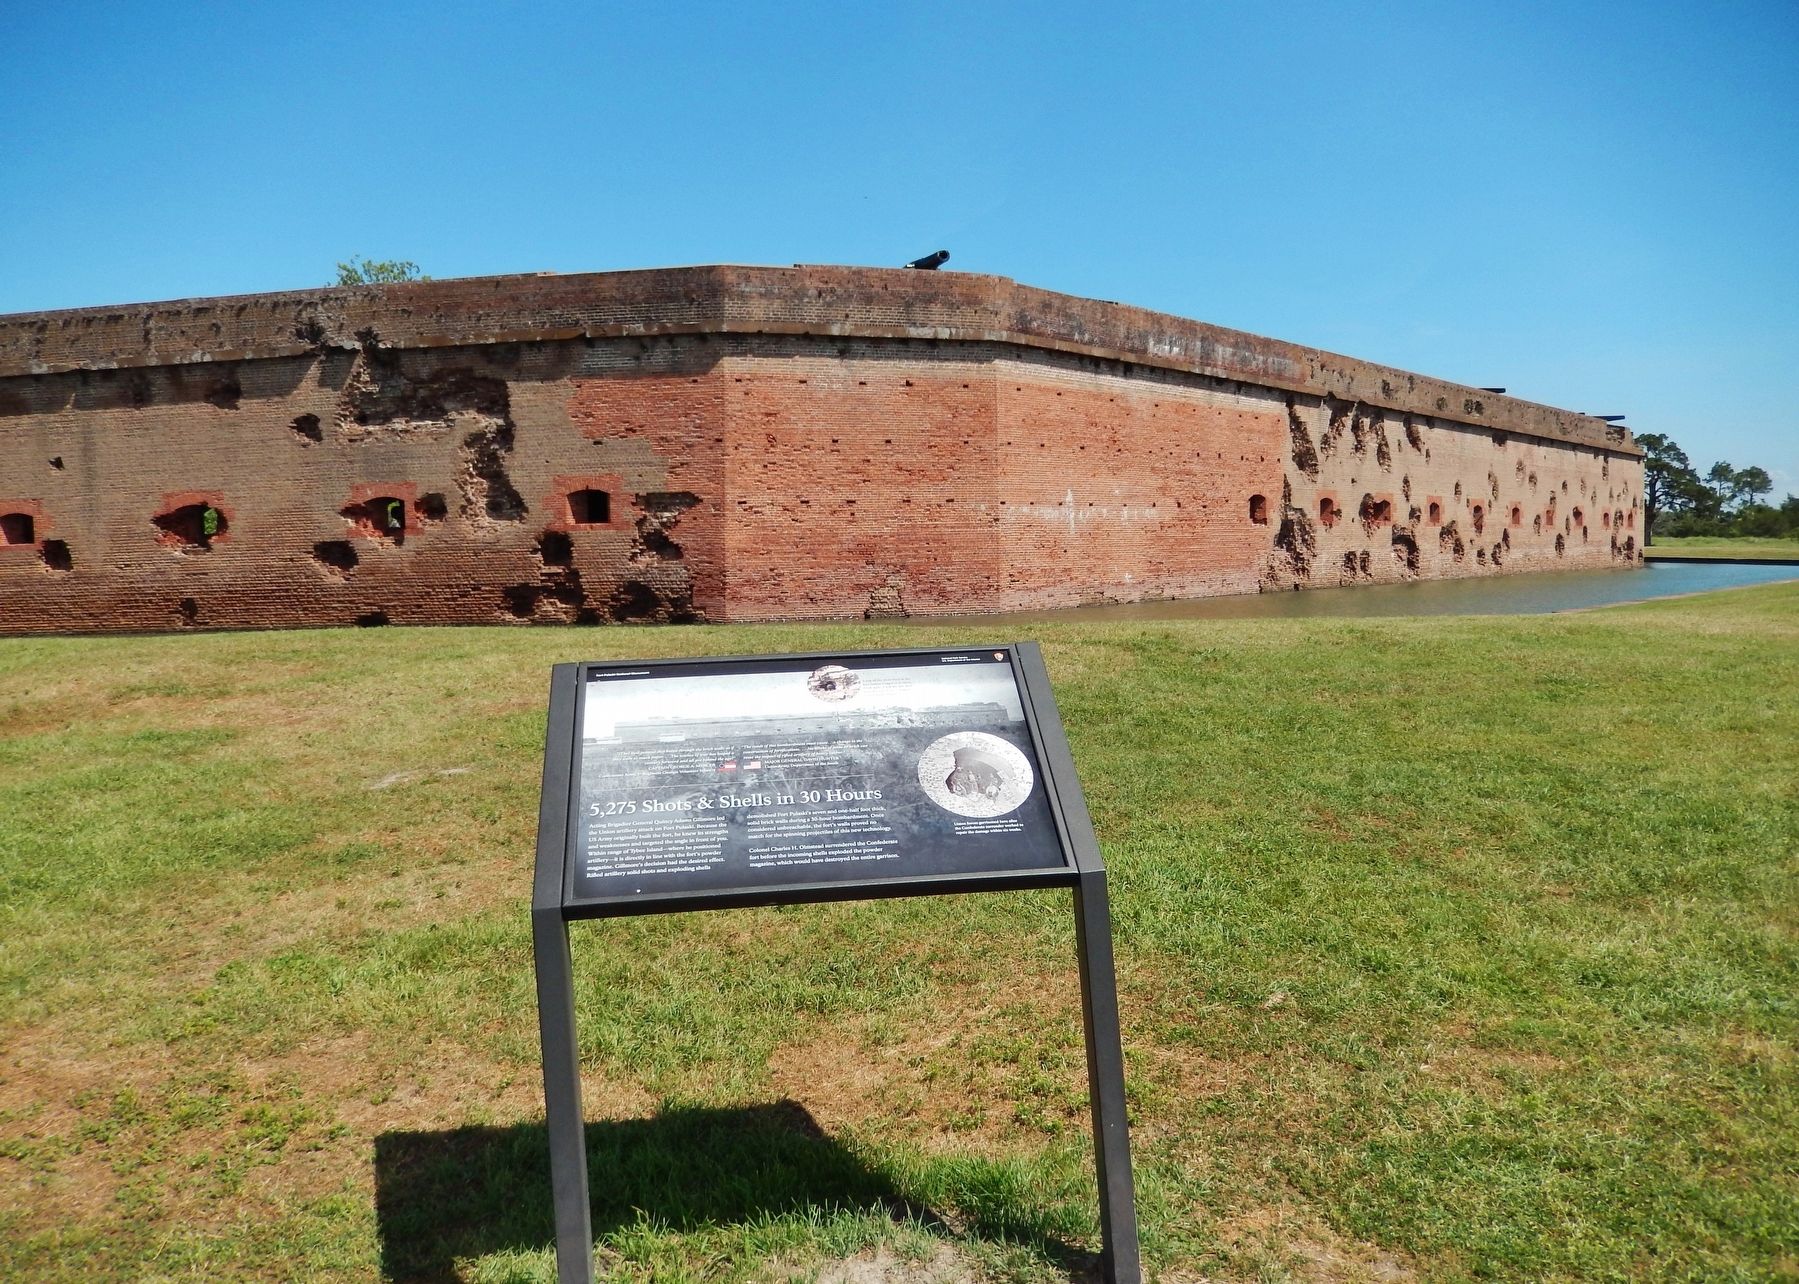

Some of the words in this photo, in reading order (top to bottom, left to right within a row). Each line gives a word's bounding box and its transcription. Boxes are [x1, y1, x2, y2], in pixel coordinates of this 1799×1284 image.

[589, 801, 637, 818] 5,275
[642, 799, 692, 813] Shots
[697, 796, 714, 810] &
[719, 793, 772, 809] Shells
[777, 792, 795, 805] in
[800, 790, 821, 804] 30
[825, 788, 882, 802] Hours
